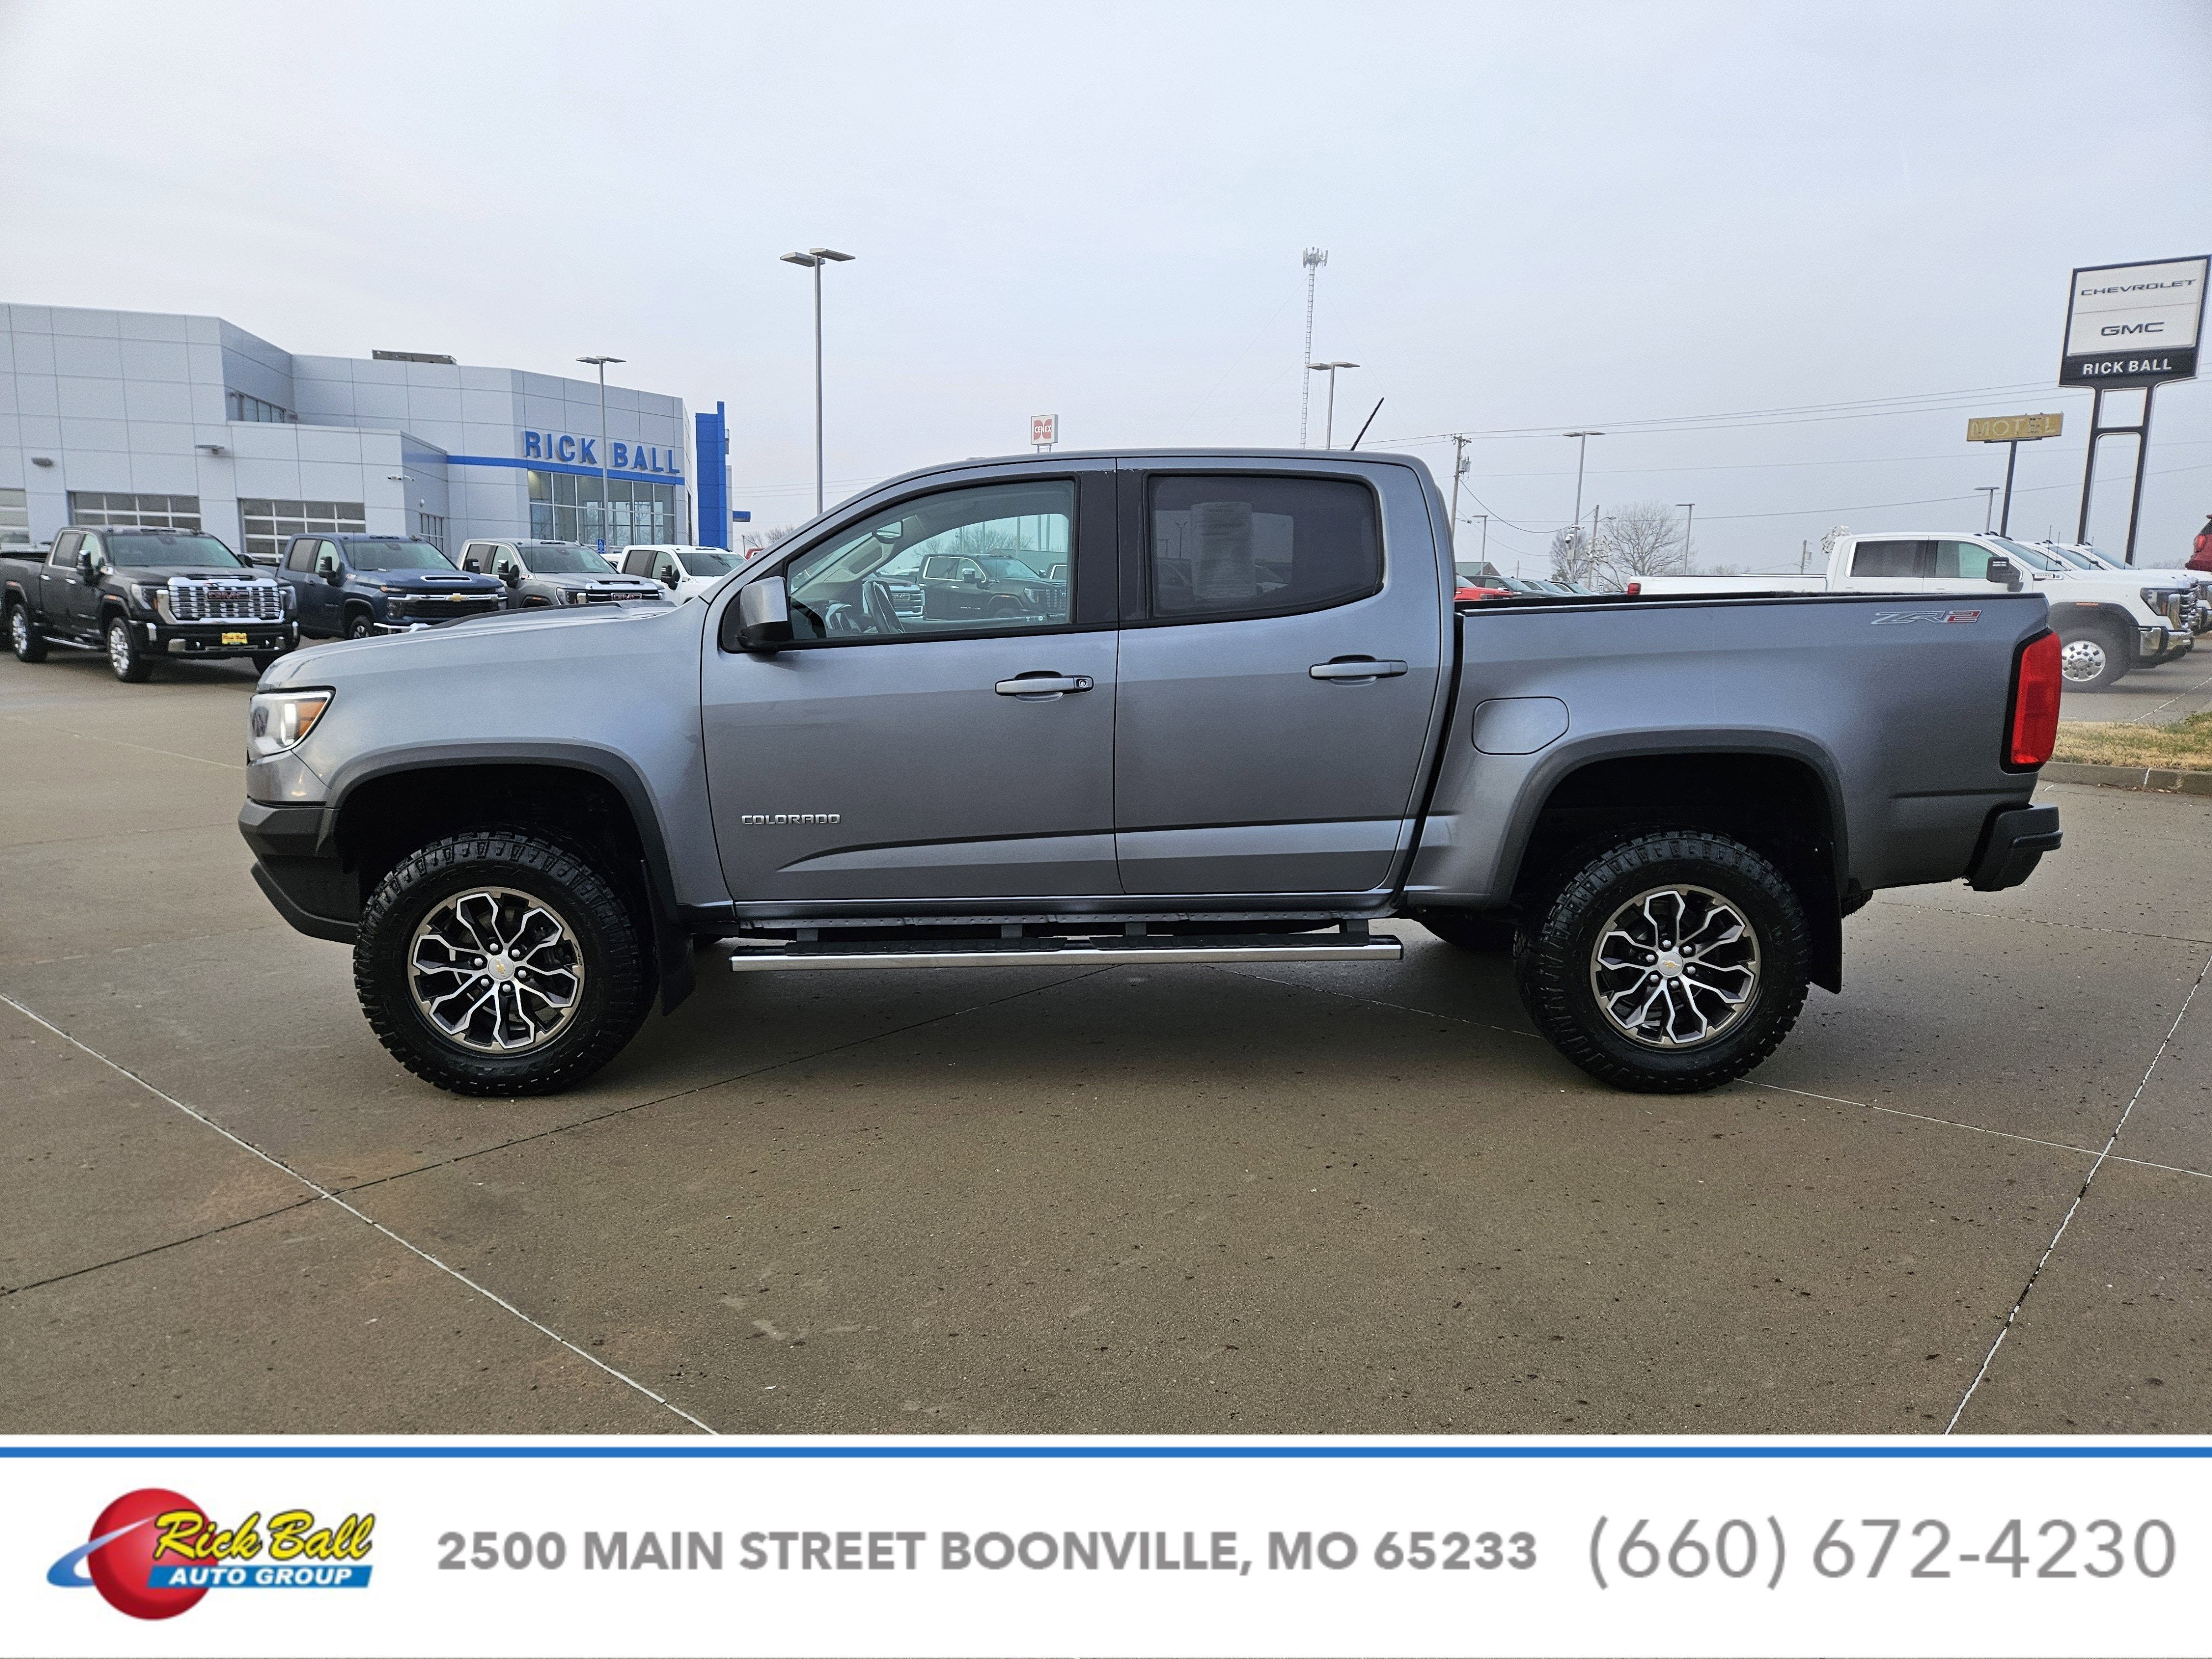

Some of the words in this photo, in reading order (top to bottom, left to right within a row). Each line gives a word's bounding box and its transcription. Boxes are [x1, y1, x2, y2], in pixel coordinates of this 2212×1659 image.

[2081, 279, 2197, 296] CHEVROLET
[2101, 321, 2165, 336] GMC
[2083, 361, 2124, 375] RICK
[2128, 358, 2172, 373] BALL
[1034, 425, 1052, 433] CENEX
[1971, 415, 2057, 437] MOTEL
[524, 430, 597, 464] RICK
[613, 442, 680, 473] BALL
[1870, 610, 1984, 625] ZR2
[741, 814, 841, 825] COLORADO
